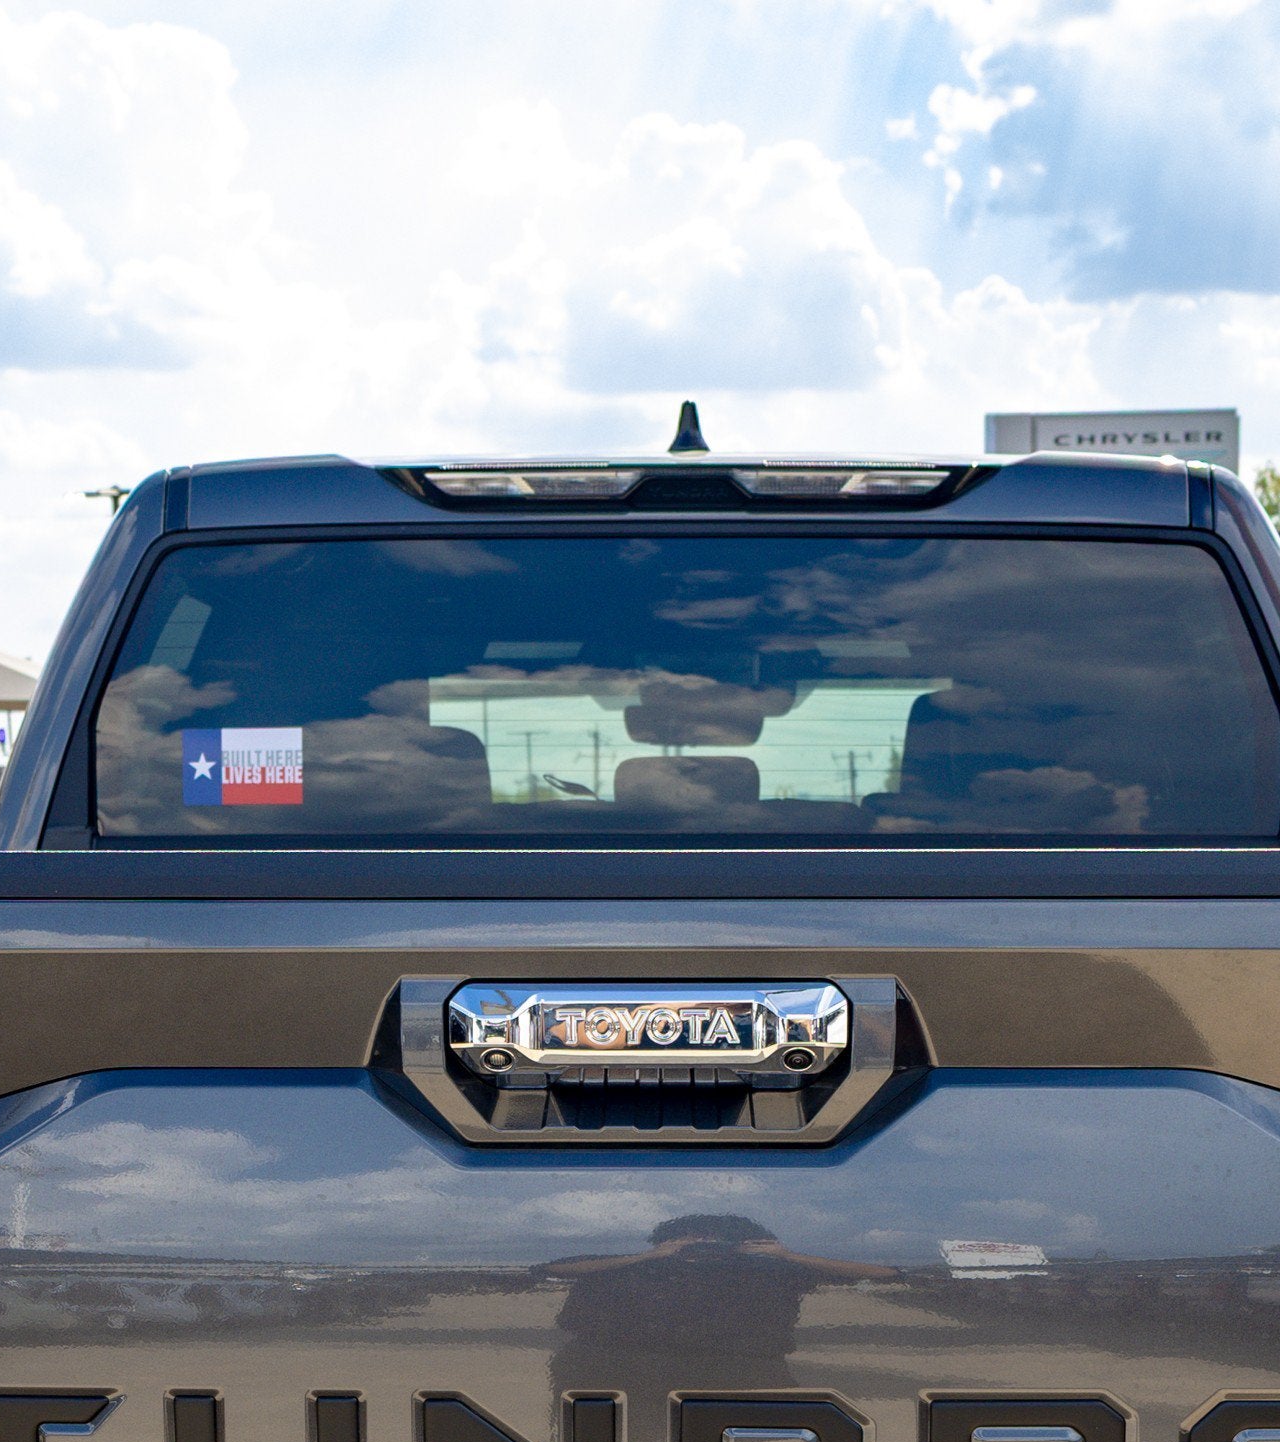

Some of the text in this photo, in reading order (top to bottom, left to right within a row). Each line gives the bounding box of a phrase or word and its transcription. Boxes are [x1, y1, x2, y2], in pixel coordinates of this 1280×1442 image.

[1053, 430, 1223, 447] CHRYSLER
[222, 750, 302, 766] BUILT HERE
[222, 767, 303, 784] LIVES HERE
[555, 1008, 741, 1045] TOYOTA
